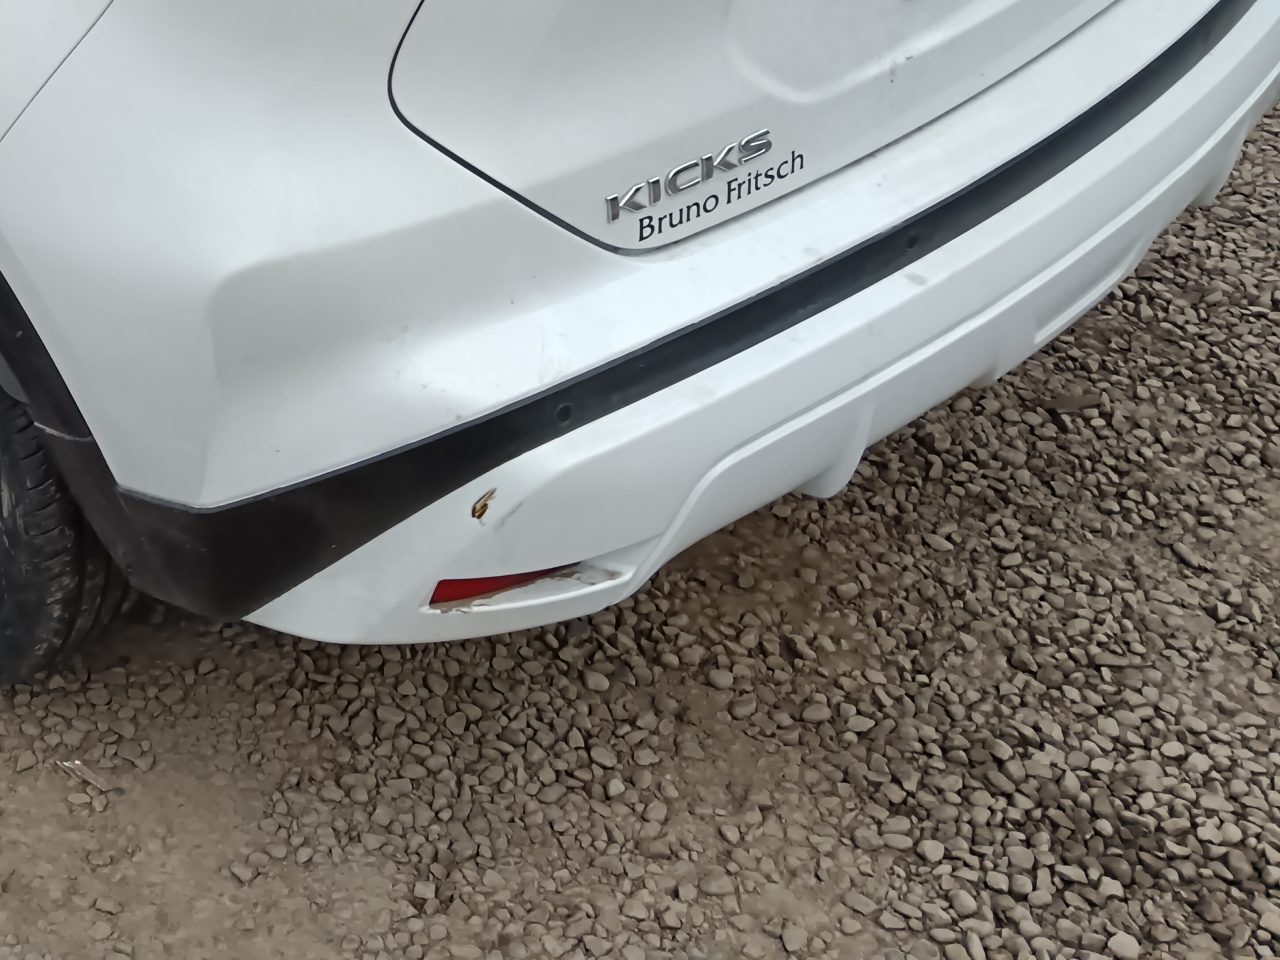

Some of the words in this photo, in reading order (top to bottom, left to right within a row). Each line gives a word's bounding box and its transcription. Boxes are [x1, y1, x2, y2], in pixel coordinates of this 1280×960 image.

[605, 128, 772, 224] KICKS
[638, 193, 720, 242] Bruno
[726, 150, 804, 205] Fritsch
